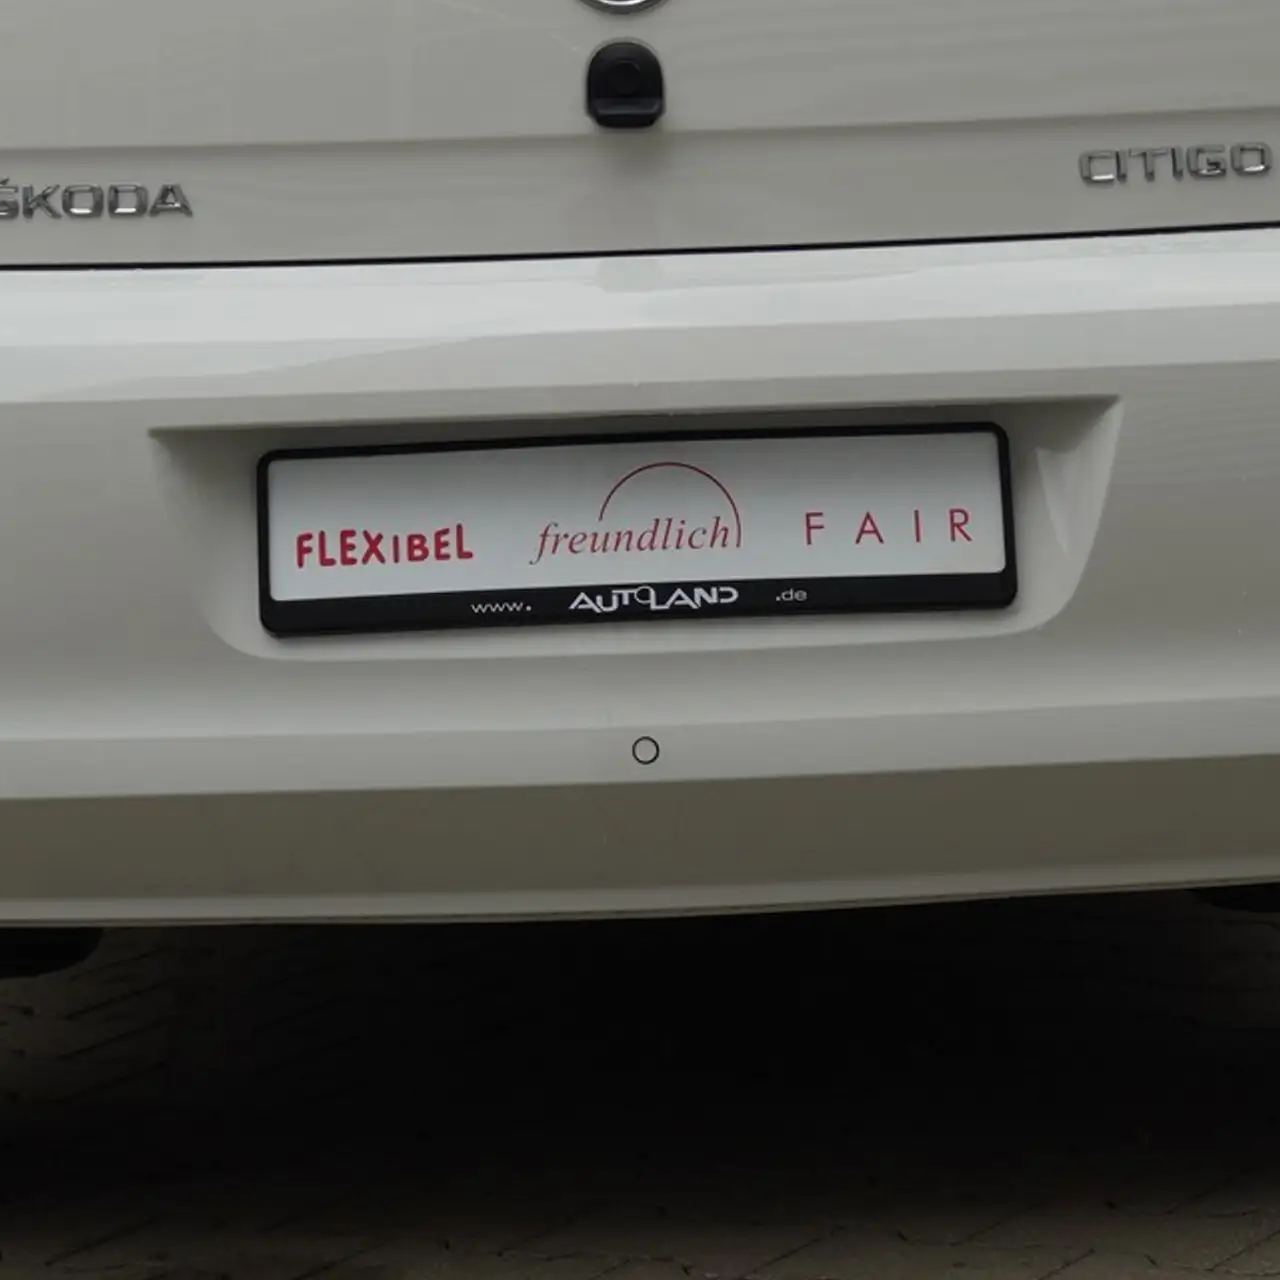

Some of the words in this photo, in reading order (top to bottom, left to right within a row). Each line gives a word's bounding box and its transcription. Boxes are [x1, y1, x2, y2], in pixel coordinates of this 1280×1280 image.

[1078, 141, 1273, 184] CITIGO
[295, 523, 474, 569] FLEXIBEL
[528, 514, 731, 566] freundlich
[569, 585, 740, 614] AUTOLAND
